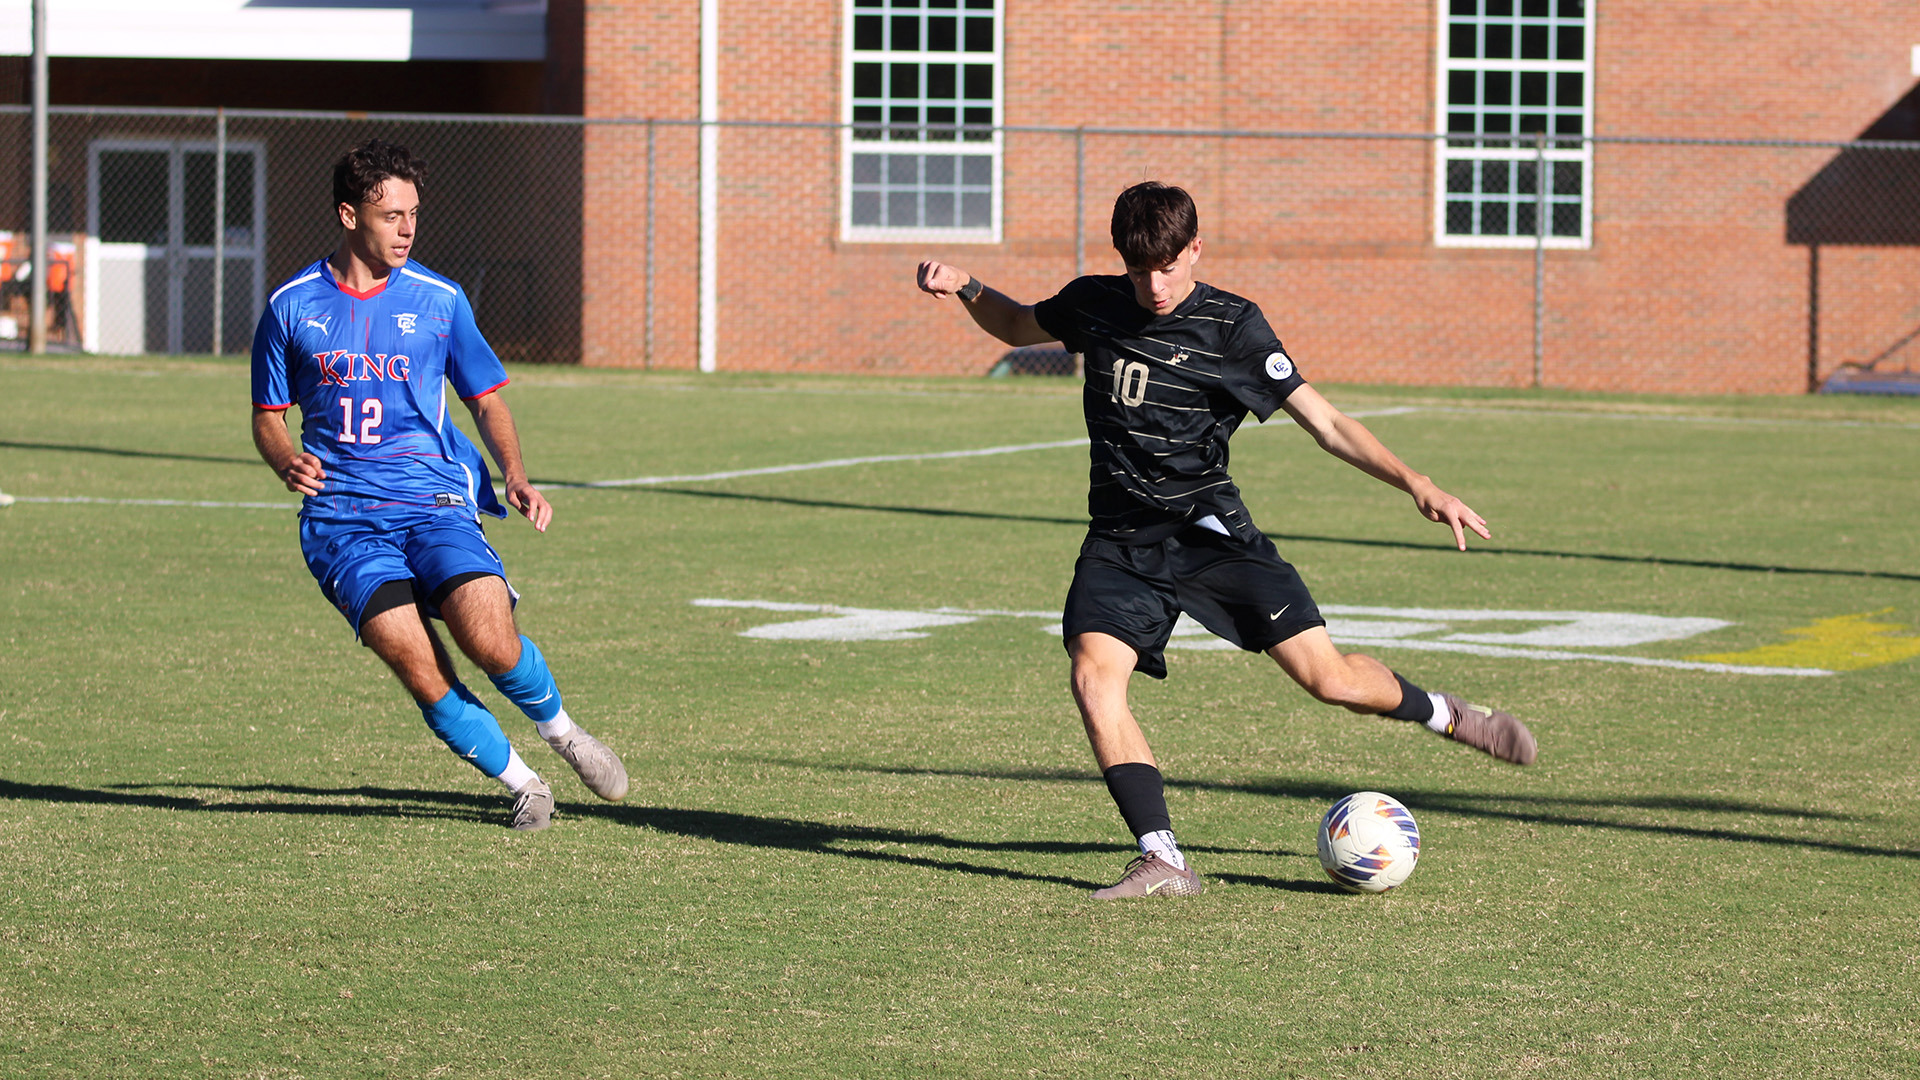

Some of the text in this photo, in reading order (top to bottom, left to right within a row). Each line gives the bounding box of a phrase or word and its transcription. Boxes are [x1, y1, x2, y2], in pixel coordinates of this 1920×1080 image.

[312, 349, 410, 387] KING
[1111, 358, 1150, 408] 10
[338, 396, 383, 445] 12
